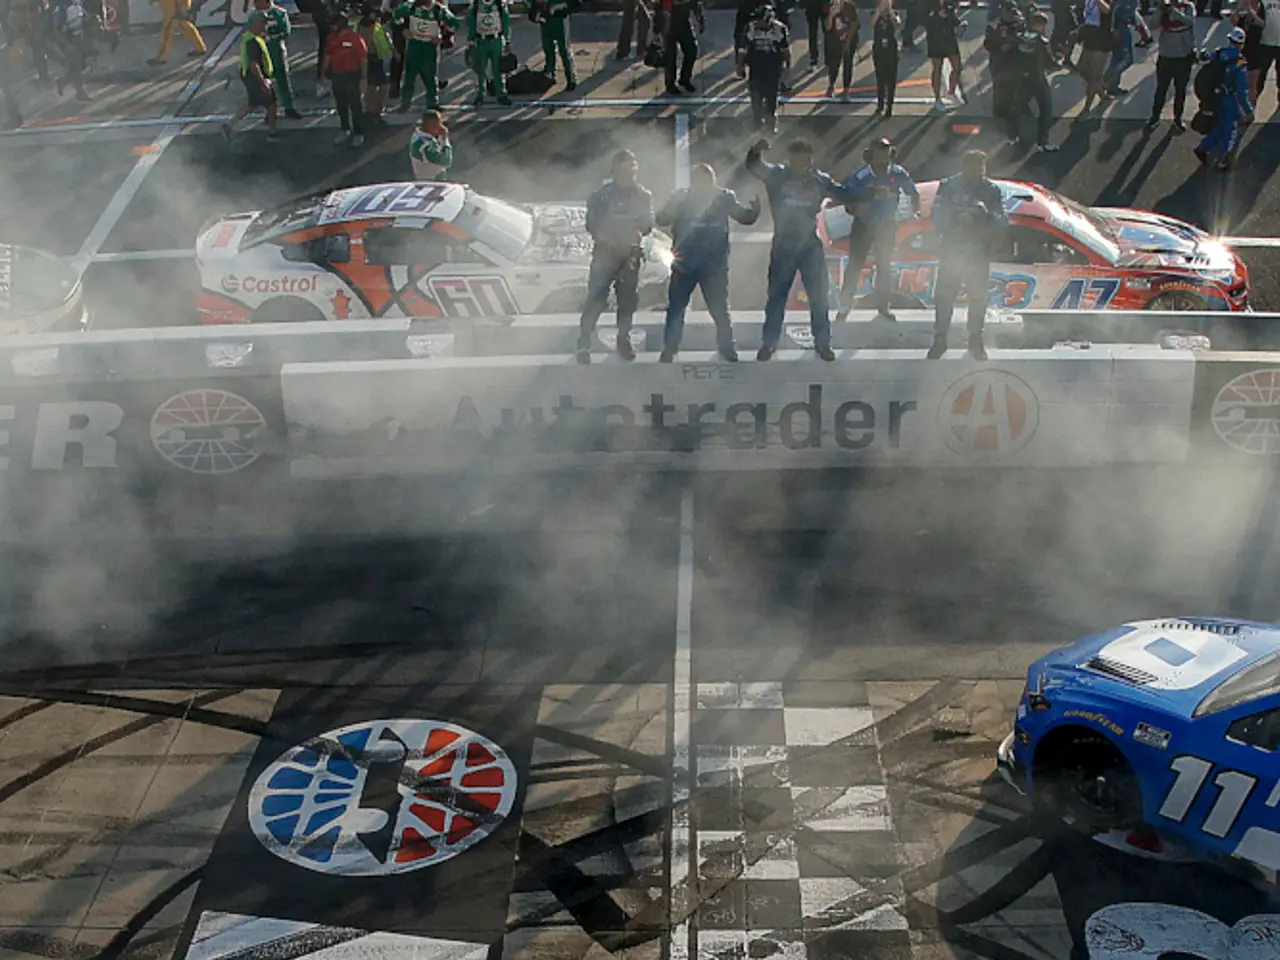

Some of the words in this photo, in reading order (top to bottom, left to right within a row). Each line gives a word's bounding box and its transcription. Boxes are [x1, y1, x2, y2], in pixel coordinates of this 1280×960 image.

[242, 274, 318, 294] Castrol
[682, 364, 734, 380] PEPE
[1063, 709, 1124, 735] GOODYEAR
[1159, 753, 1258, 839] 11
